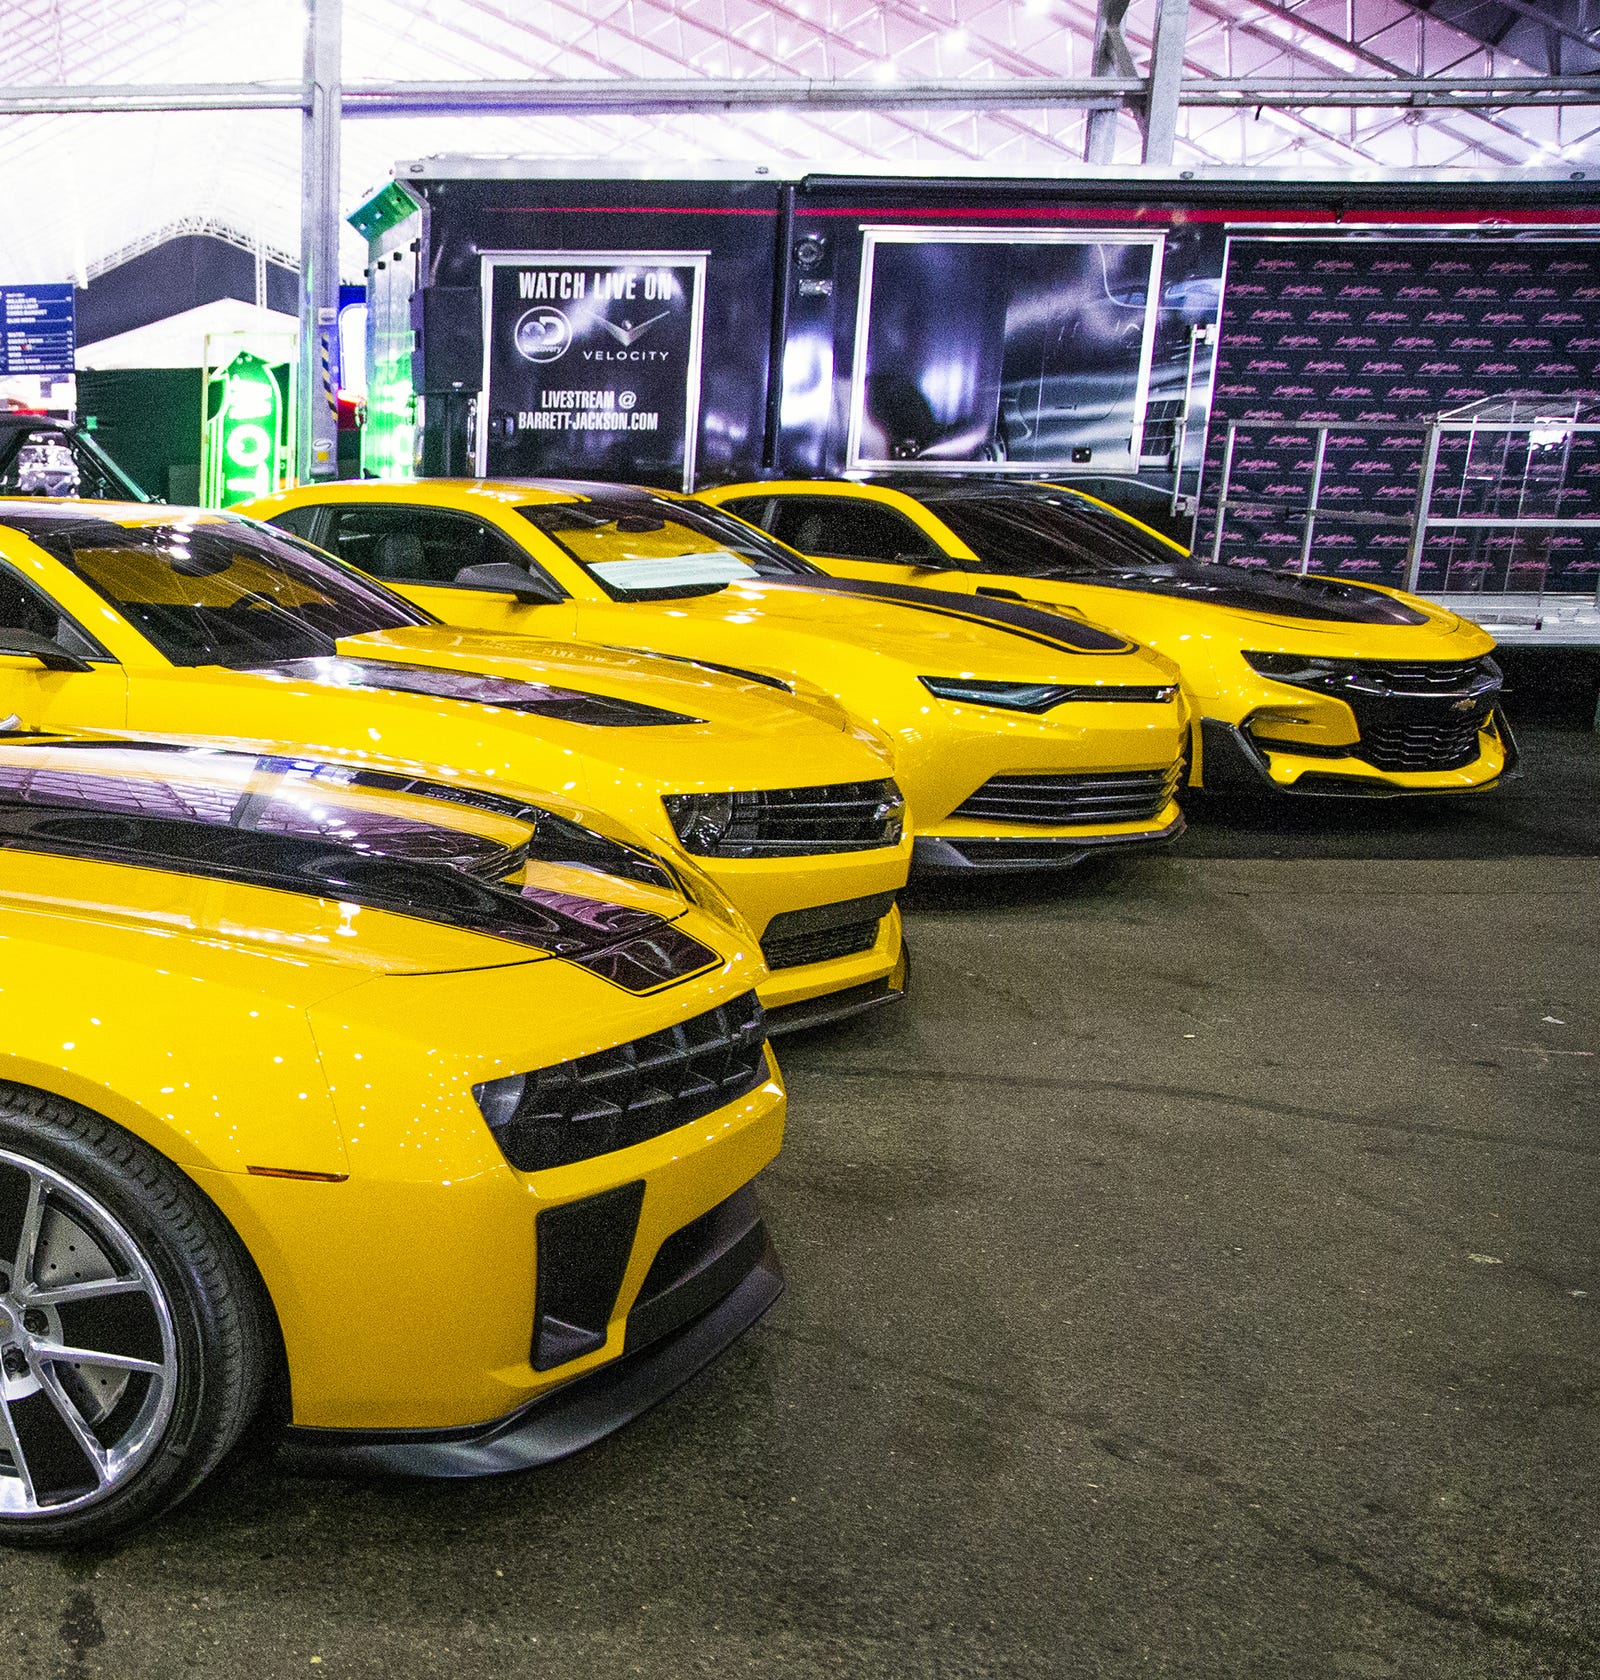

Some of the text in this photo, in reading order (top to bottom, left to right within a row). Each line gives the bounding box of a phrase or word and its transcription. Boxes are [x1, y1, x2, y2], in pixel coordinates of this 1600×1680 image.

[519, 272, 672, 301] WATCH LIVE ON
[583, 350, 669, 361] VELOCITY
[541, 390, 637, 409] LIVESTREAM @
[518, 411, 659, 431] BARRETT-JACKSON.COM
